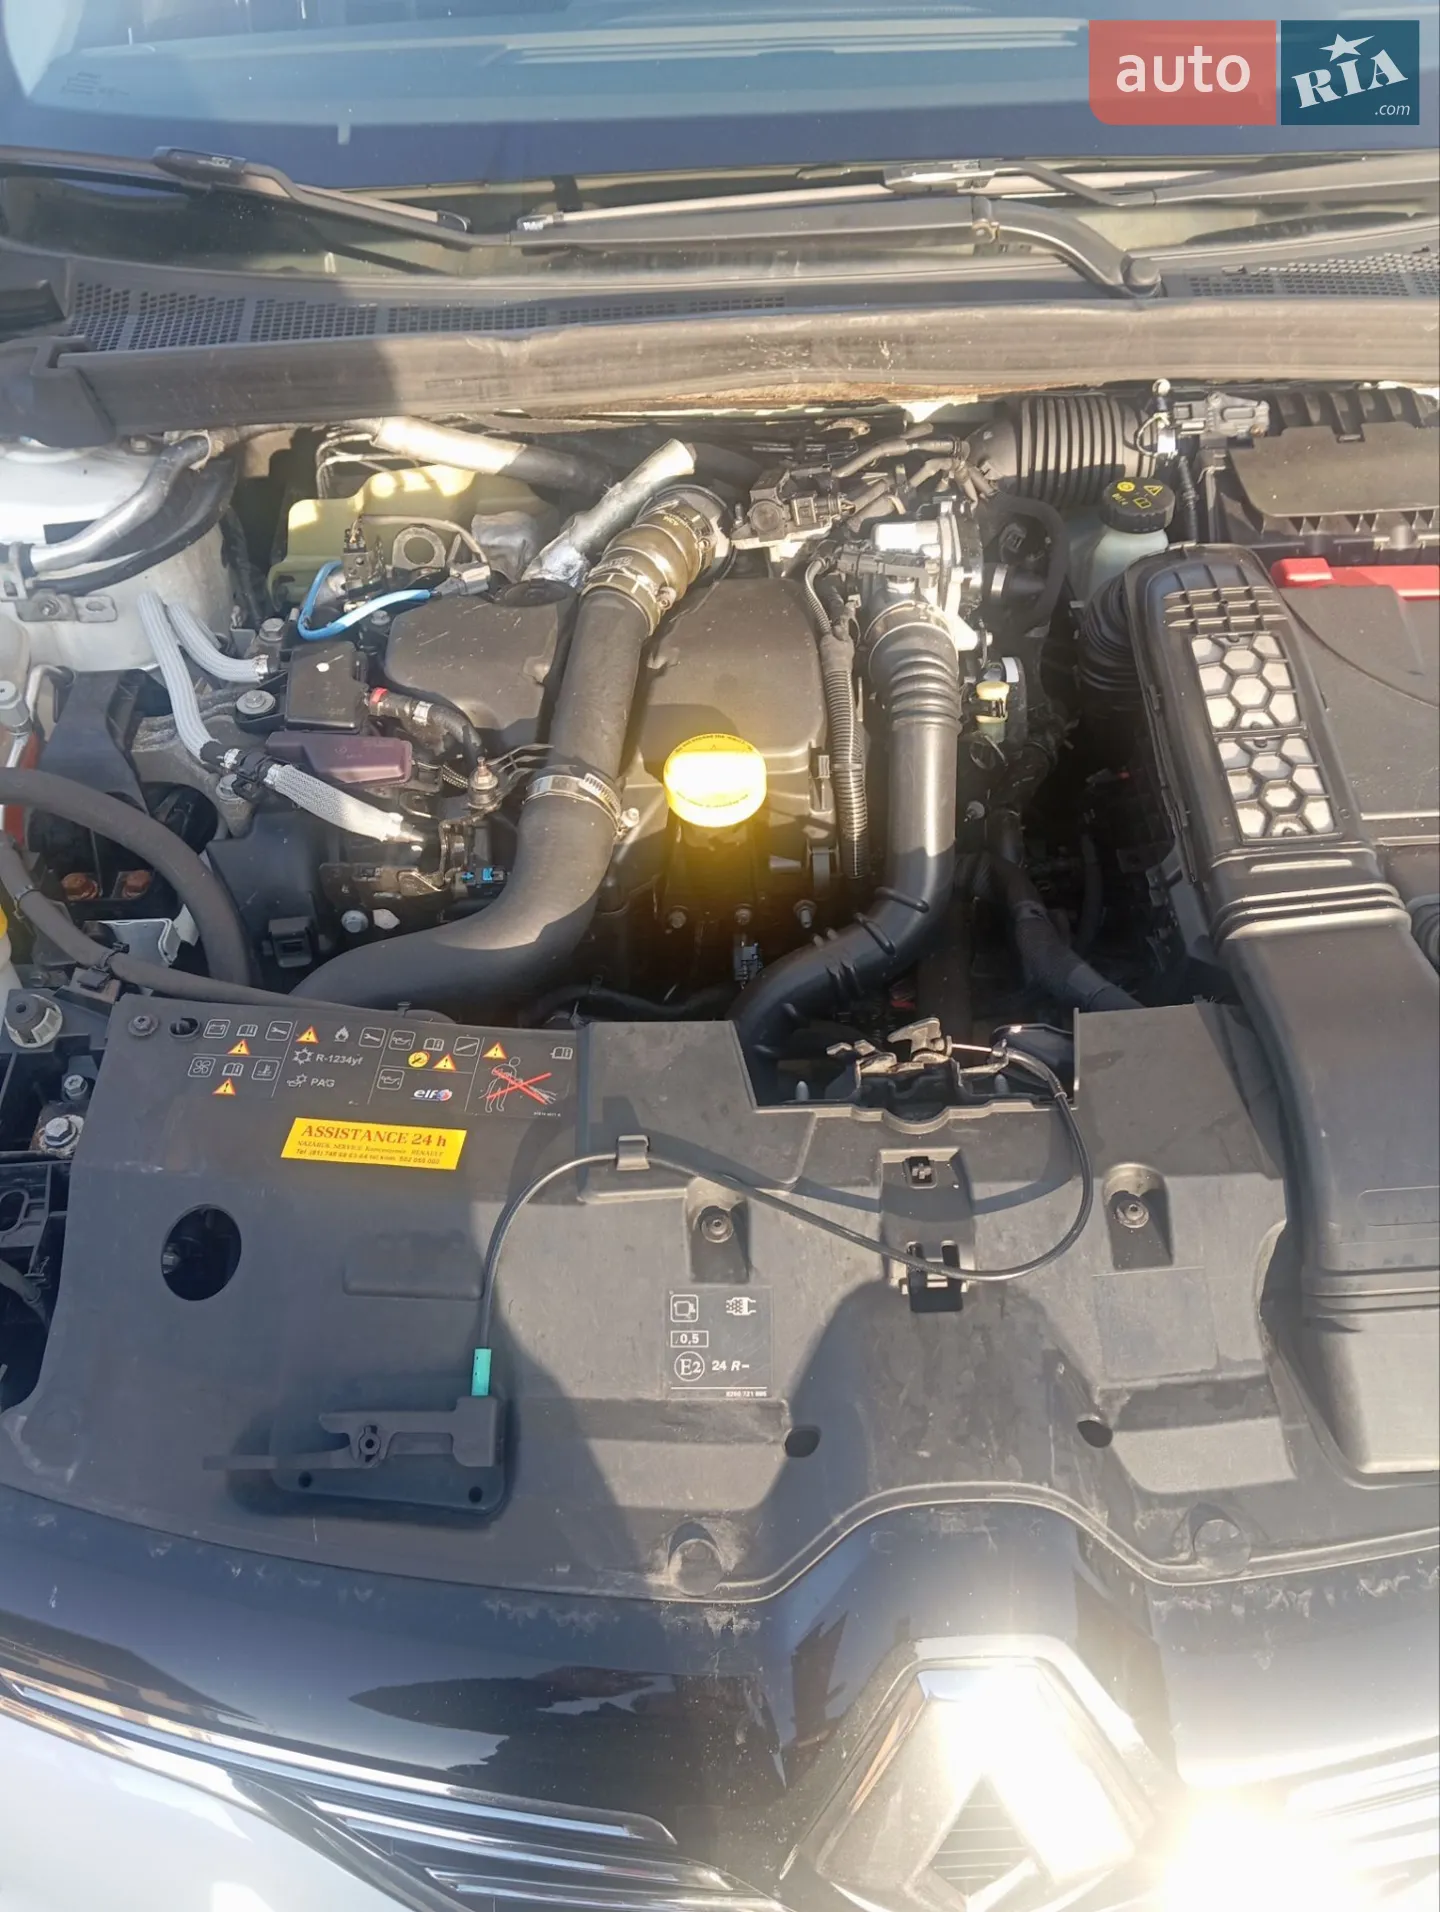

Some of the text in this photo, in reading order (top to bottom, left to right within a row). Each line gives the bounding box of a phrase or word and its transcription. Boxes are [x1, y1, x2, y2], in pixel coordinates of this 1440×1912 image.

[315, 1053, 364, 1066] R-1234yf
[310, 1077, 336, 1088] PAG
[413, 1088, 439, 1099] elf
[301, 1125, 447, 1147] ASSISTANCE 24 h
[411, 1149, 444, 1157] RENAULT
[680, 1333, 699, 1345] 0,5
[680, 1358, 701, 1376] E2
[711, 1360, 727, 1371] 24
